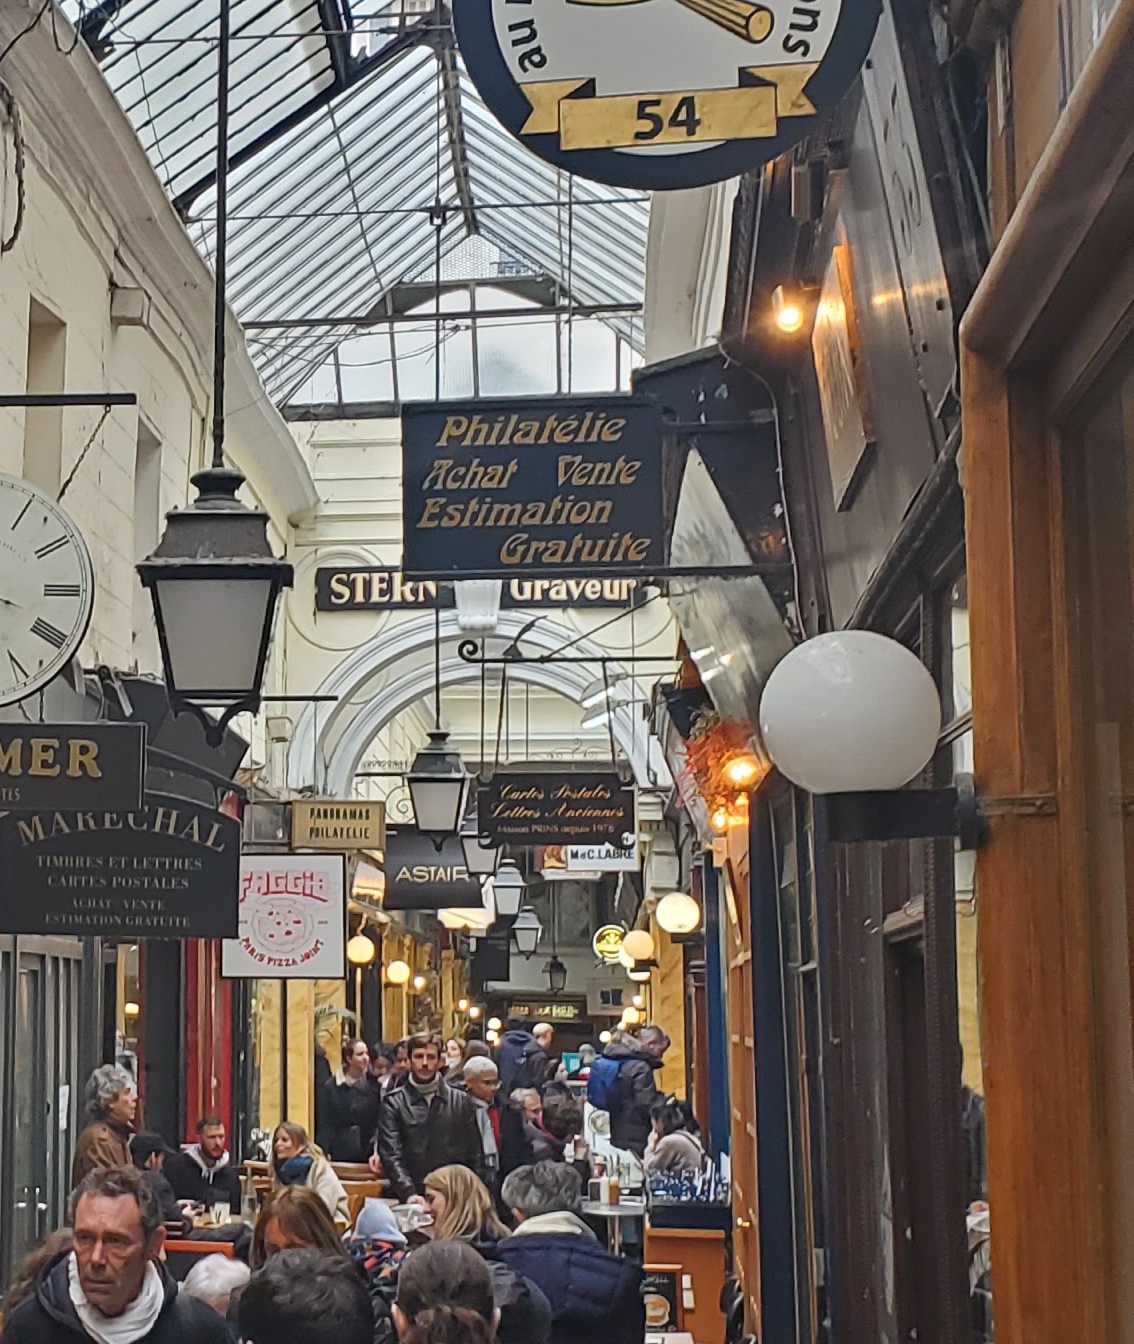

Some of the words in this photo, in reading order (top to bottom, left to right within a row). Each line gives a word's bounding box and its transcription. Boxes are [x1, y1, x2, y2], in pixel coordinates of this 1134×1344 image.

[508, 18, 548, 74] au
[634, 95, 701, 141] 54
[436, 411, 627, 448] Philatélie
[422, 457, 518, 491] Achat
[557, 455, 642, 487] Vente
[417, 495, 613, 529] Estimation
[500, 531, 652, 565] Gratuite
[330, 571, 438, 605] STERN
[509, 578, 636, 602] Graveur
[309, 807, 371, 822] PANORAMAS
[309, 826, 371, 841] PHILATELIE
[36, 855, 103, 868] TIMBRES
[109, 856, 127, 869] ET
[133, 857, 202, 871] LETTRES
[395, 865, 471, 884] ASTAIR
[47, 874, 107, 888] CARTES
[112, 875, 190, 890] POSTALES
[45, 913, 122, 926] ESTIMATION
[125, 914, 191, 928] GRATUITE
[239, 937, 266, 963] PARIS
[267, 955, 299, 968] PIZZA
[299, 938, 325, 964] JOINT
